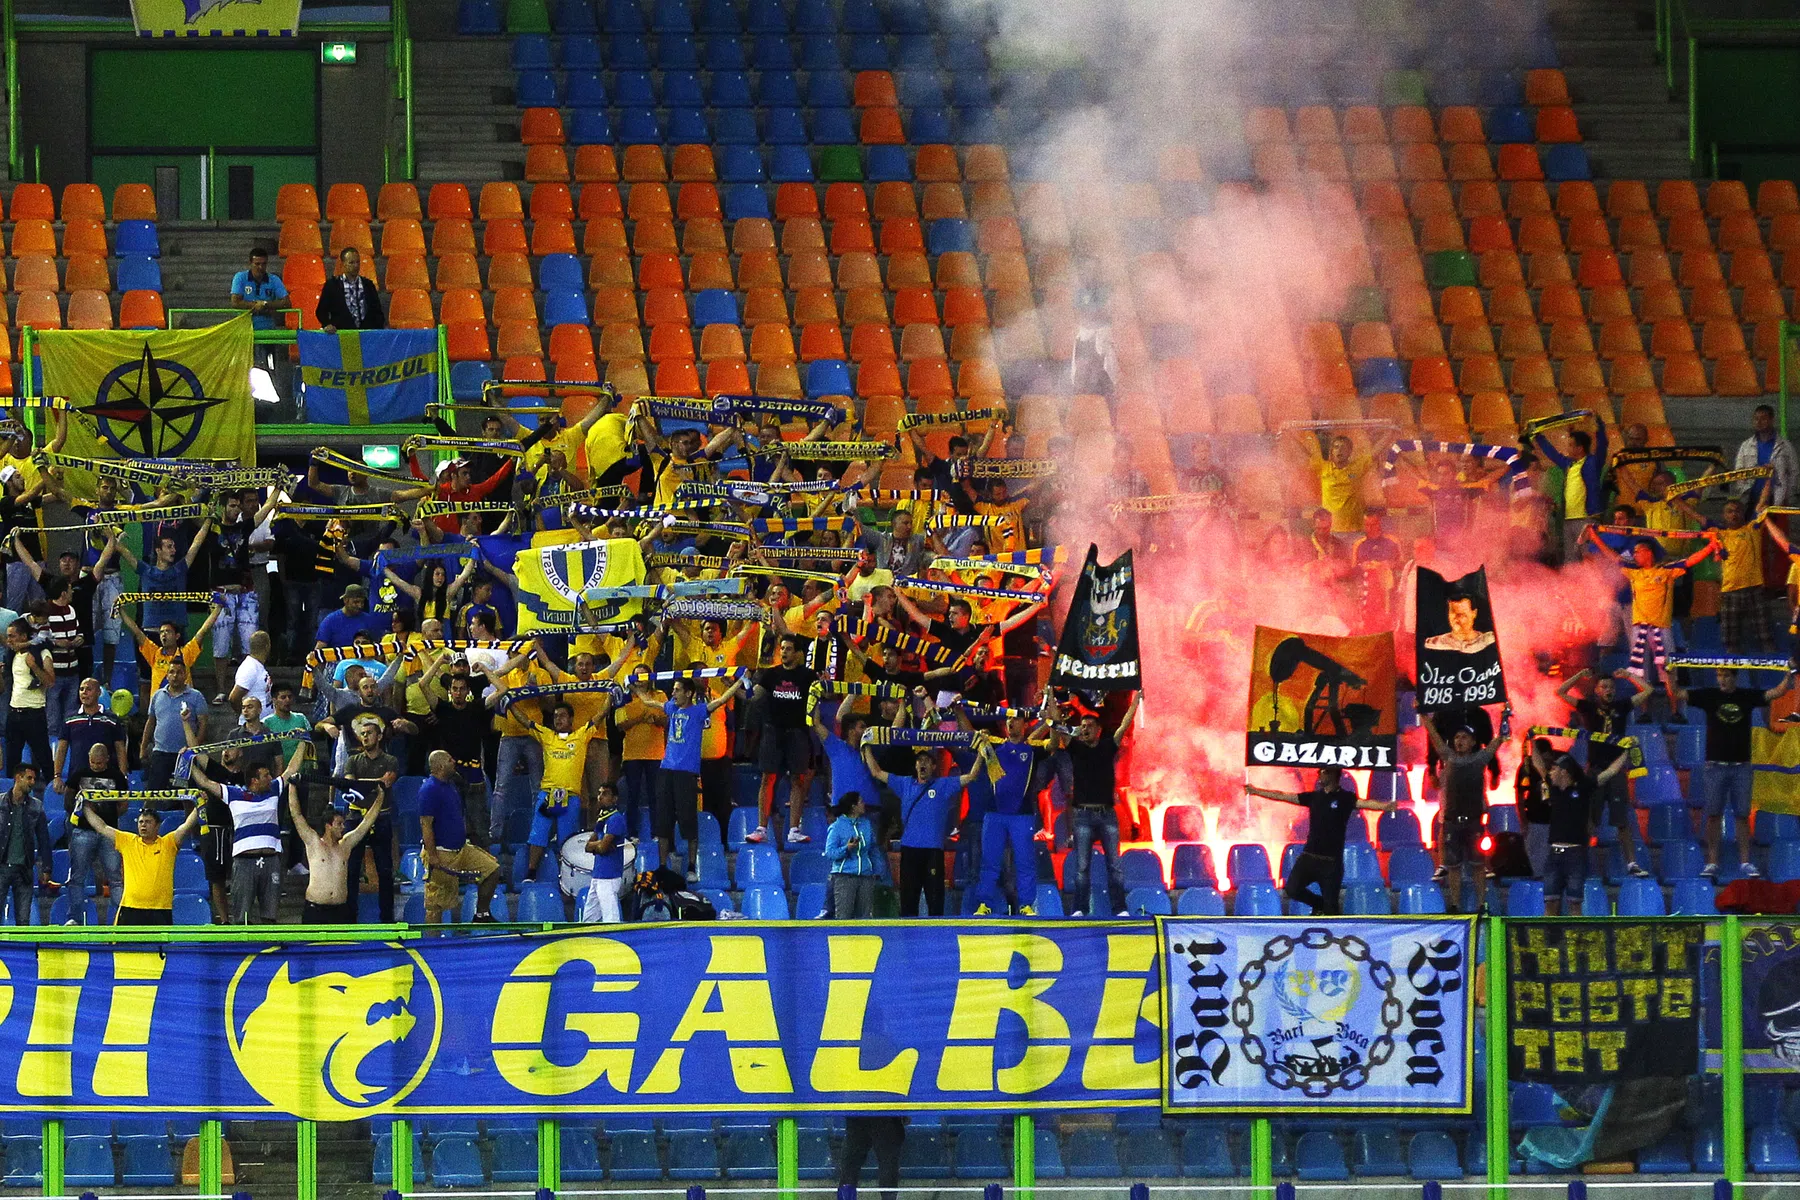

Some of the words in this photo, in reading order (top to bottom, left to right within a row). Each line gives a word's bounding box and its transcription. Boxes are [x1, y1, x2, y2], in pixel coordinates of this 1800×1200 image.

[319, 357, 428, 387] PETROLUL
[732, 399, 756, 408] F.C.
[758, 400, 825, 416] PETROLUL
[902, 414, 934, 430] LUPII
[939, 408, 992, 423] GALBENI
[55, 455, 93, 471] LUPII
[100, 464, 162, 485] GALBENI
[681, 484, 729, 497] PETROLUL
[101, 512, 135, 523] LUPII
[143, 504, 201, 521] GALBENI
[421, 499, 457, 515] LUPII
[461, 502, 515, 512] GALBEN
[1060, 654, 1137, 679] pentru
[538, 679, 614, 693] PETROLUL
[1423, 687, 1453, 705] 1918
[1464, 683, 1497, 702] 1993
[892, 728, 911, 741] F.C.
[1253, 741, 1392, 767] GAZARII
[119, 789, 195, 800] PETROL
[1174, 939, 1230, 1090] Bari
[1406, 940, 1463, 1088] Boca
[1267, 1025, 1304, 1049] Bari
[1335, 1021, 1370, 1049] Boca
